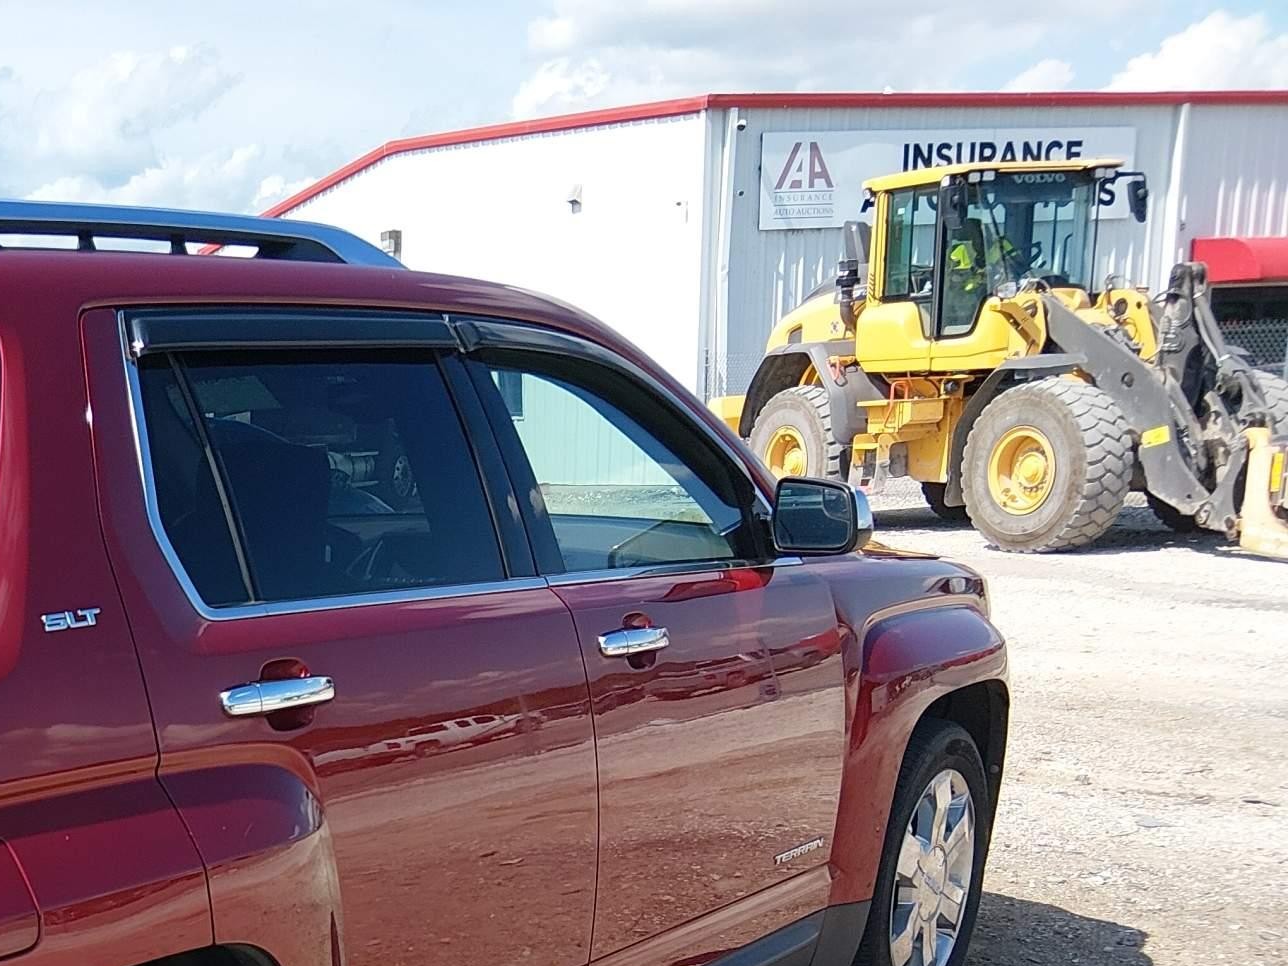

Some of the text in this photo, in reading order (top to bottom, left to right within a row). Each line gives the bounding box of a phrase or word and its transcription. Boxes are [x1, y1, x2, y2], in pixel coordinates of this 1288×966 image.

[902, 140, 1083, 172] INSURANCE
[1013, 173, 1066, 185] VOLVO
[774, 193, 834, 202] INSURANCE
[796, 206, 834, 216] AUCTIONS
[40, 607, 101, 632] SLT
[774, 836, 825, 865] TERRAIN
